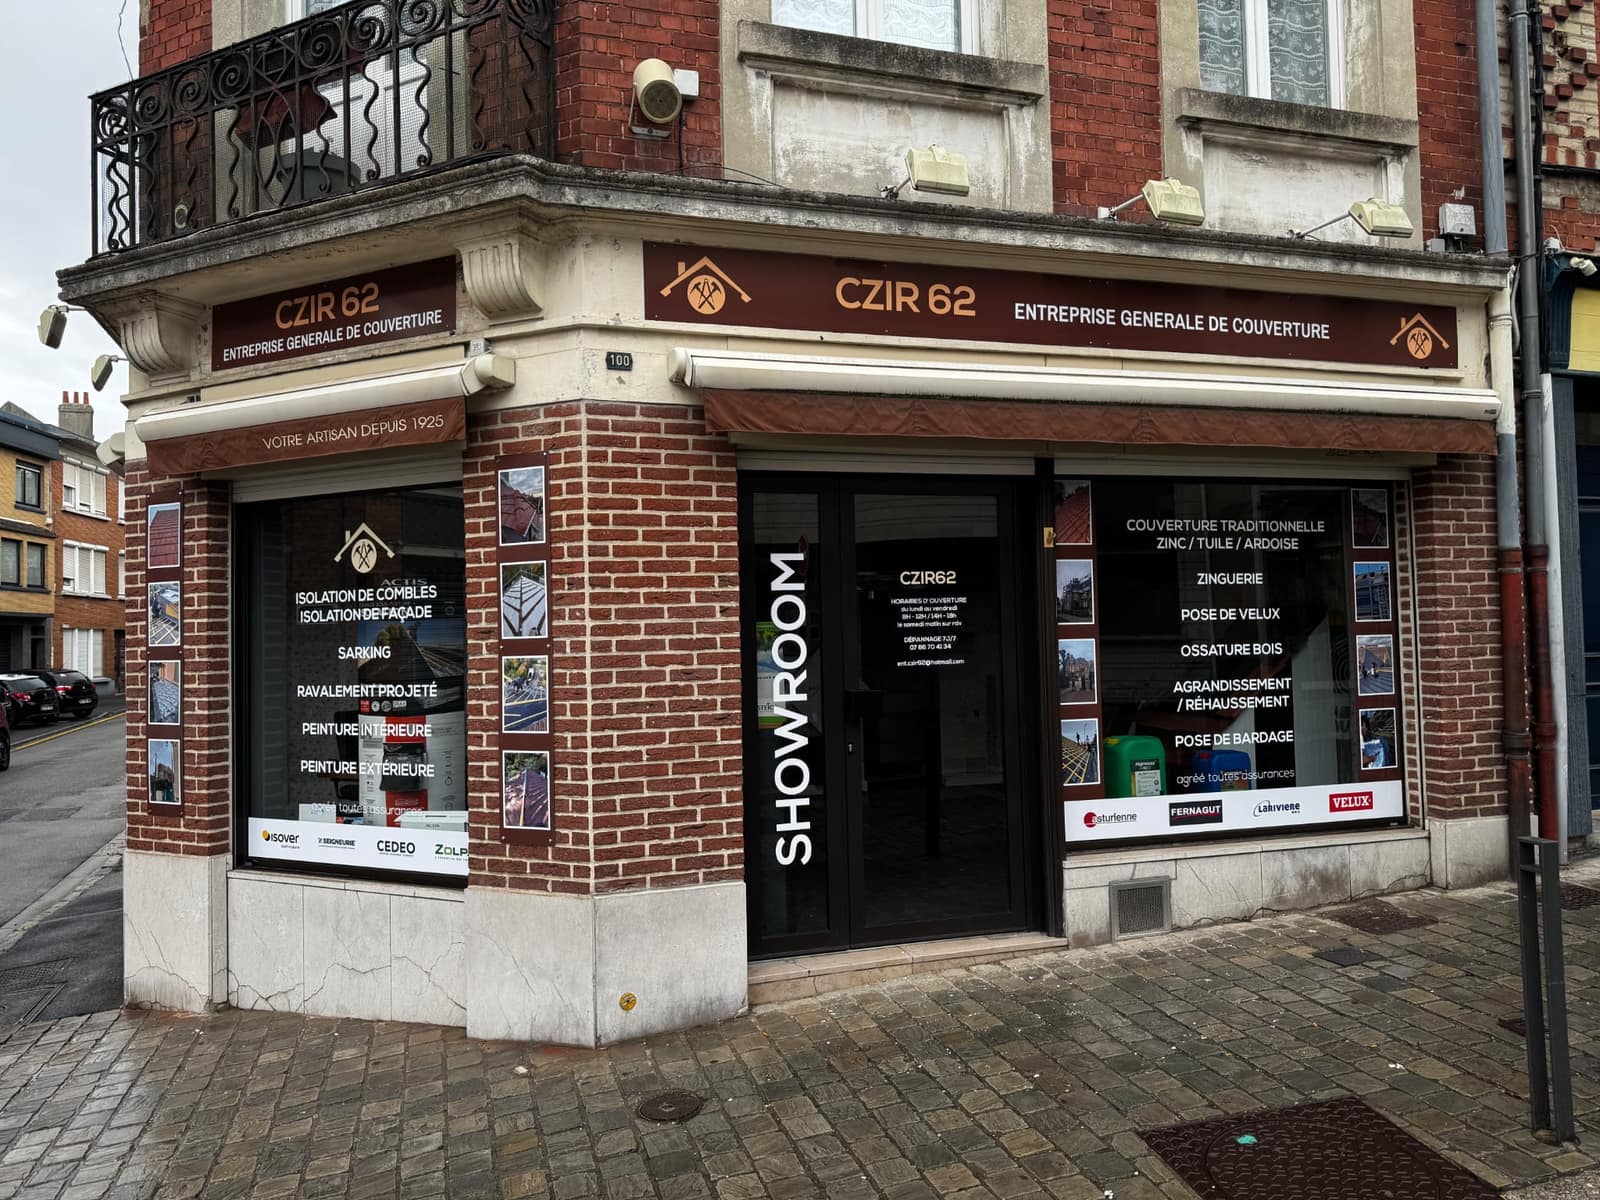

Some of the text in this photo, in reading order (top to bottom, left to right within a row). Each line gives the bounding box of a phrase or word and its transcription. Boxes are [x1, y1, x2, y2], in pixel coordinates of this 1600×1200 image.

[835, 276, 977, 318] CZIR 62
[275, 282, 380, 330] CZIR 62
[1014, 302, 1331, 340] ENTREPRISE GENERALE DE COUVERTURE
[223, 309, 443, 362] ENTREPRISE GENERALE DE COUVERTURE
[610, 354, 630, 367] 100
[262, 414, 445, 450] VOTRE ARTISAN DEPUIS 1925
[1126, 519, 1325, 534] COUVERTURE TRADITIONNELLE
[1156, 537, 1187, 550] ZINC
[1197, 537, 1234, 550] TUILE
[1244, 537, 1299, 550] ARDOISE
[381, 578, 428, 586] ACTIS
[900, 570, 957, 585] CZIR62
[1197, 573, 1263, 585] ZINGUERIE
[296, 585, 438, 605] ISOLATION DE COMBLES
[300, 605, 432, 624] ISOLATION DE FAÇADE
[1181, 608, 1281, 621] POSE DE VELUX
[338, 646, 392, 660] SARKING
[1181, 642, 1284, 657] OSSATURE BOIS
[297, 681, 438, 698] RAVALEMENT PROJETÉ
[1173, 678, 1292, 693] AGRANDISSEMENT
[770, 552, 813, 866] SHOWROOM
[1186, 695, 1290, 711] RÉHAUSSEMENT
[302, 720, 432, 738] PEINTURE INTÉRIEURE
[1175, 730, 1294, 748] POSE DE BARDAGE
[300, 759, 435, 778] PEINTURE EXTÉRIEURE
[1176, 769, 1295, 787] agréé toutes assurances
[339, 803, 368, 815] toutes
[1333, 795, 1371, 808] VELUX
[1171, 805, 1221, 816] FERNAGUT
[377, 839, 416, 854] CEDEO
[434, 843, 469, 857] ZOLP
